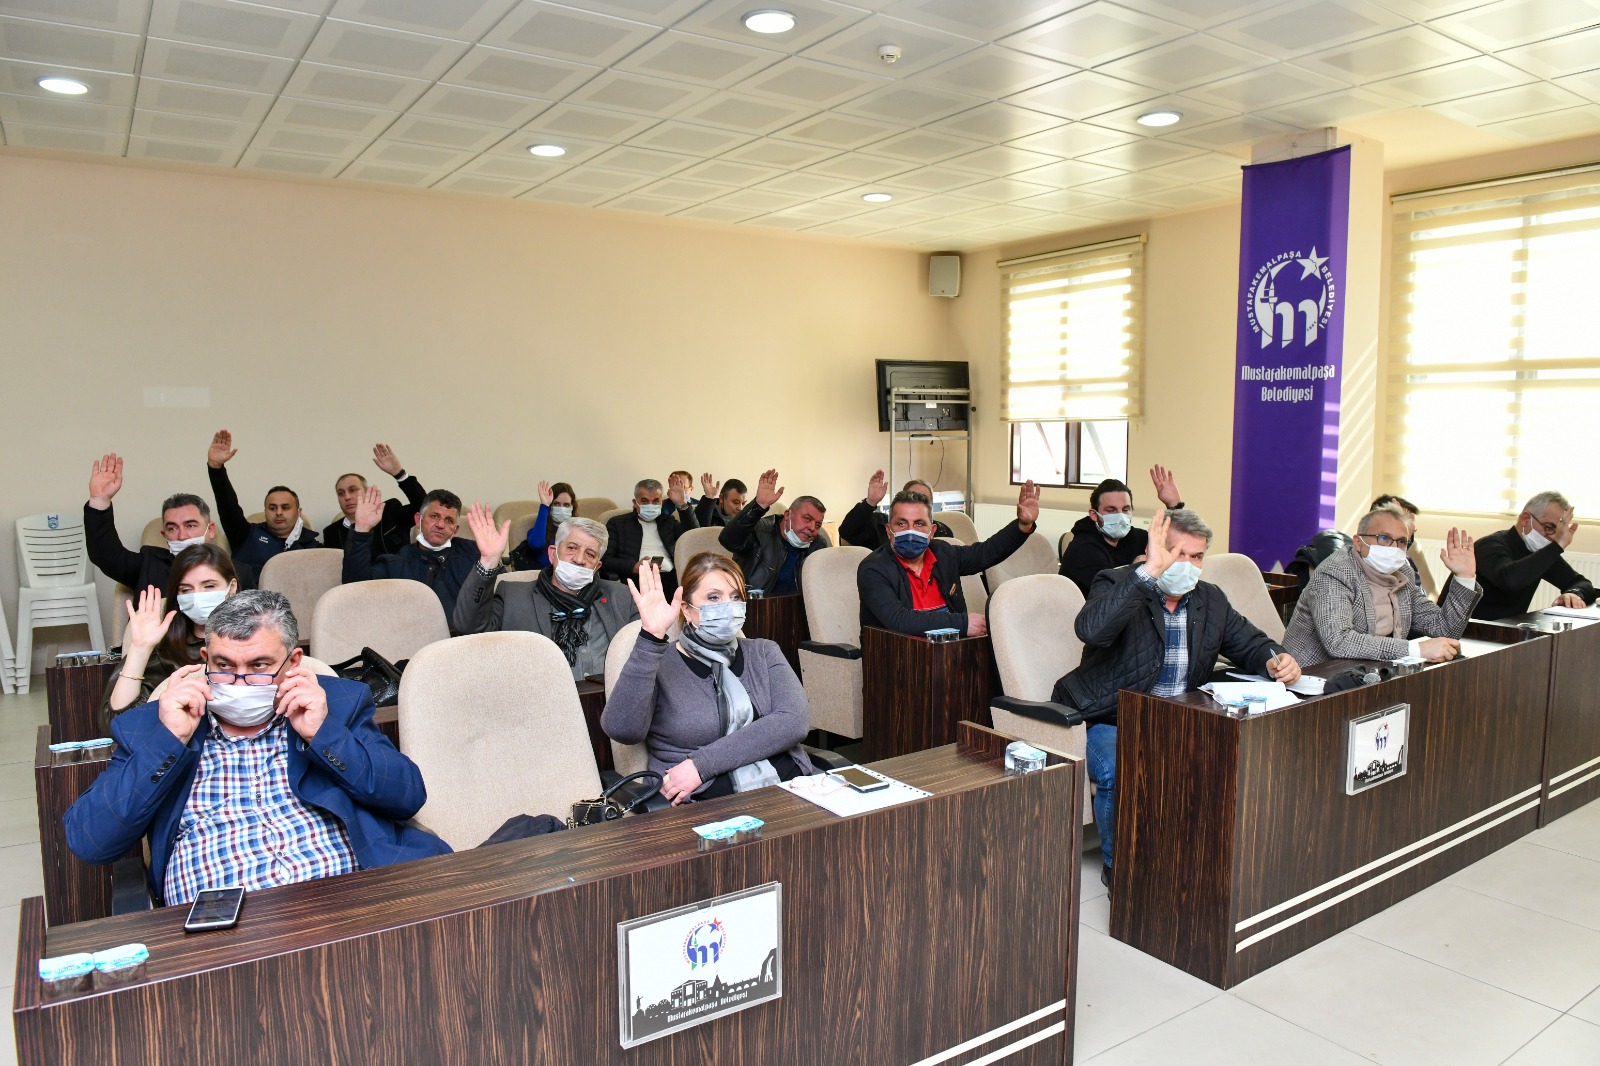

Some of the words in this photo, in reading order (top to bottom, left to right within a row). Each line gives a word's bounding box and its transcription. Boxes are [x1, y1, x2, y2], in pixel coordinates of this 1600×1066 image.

[1246, 251, 1302, 333] MUSTAFAKEMALPAŞA
[1241, 364, 1335, 382] Mustafakemalpaşa
[1261, 385, 1314, 404] Belediyesi
